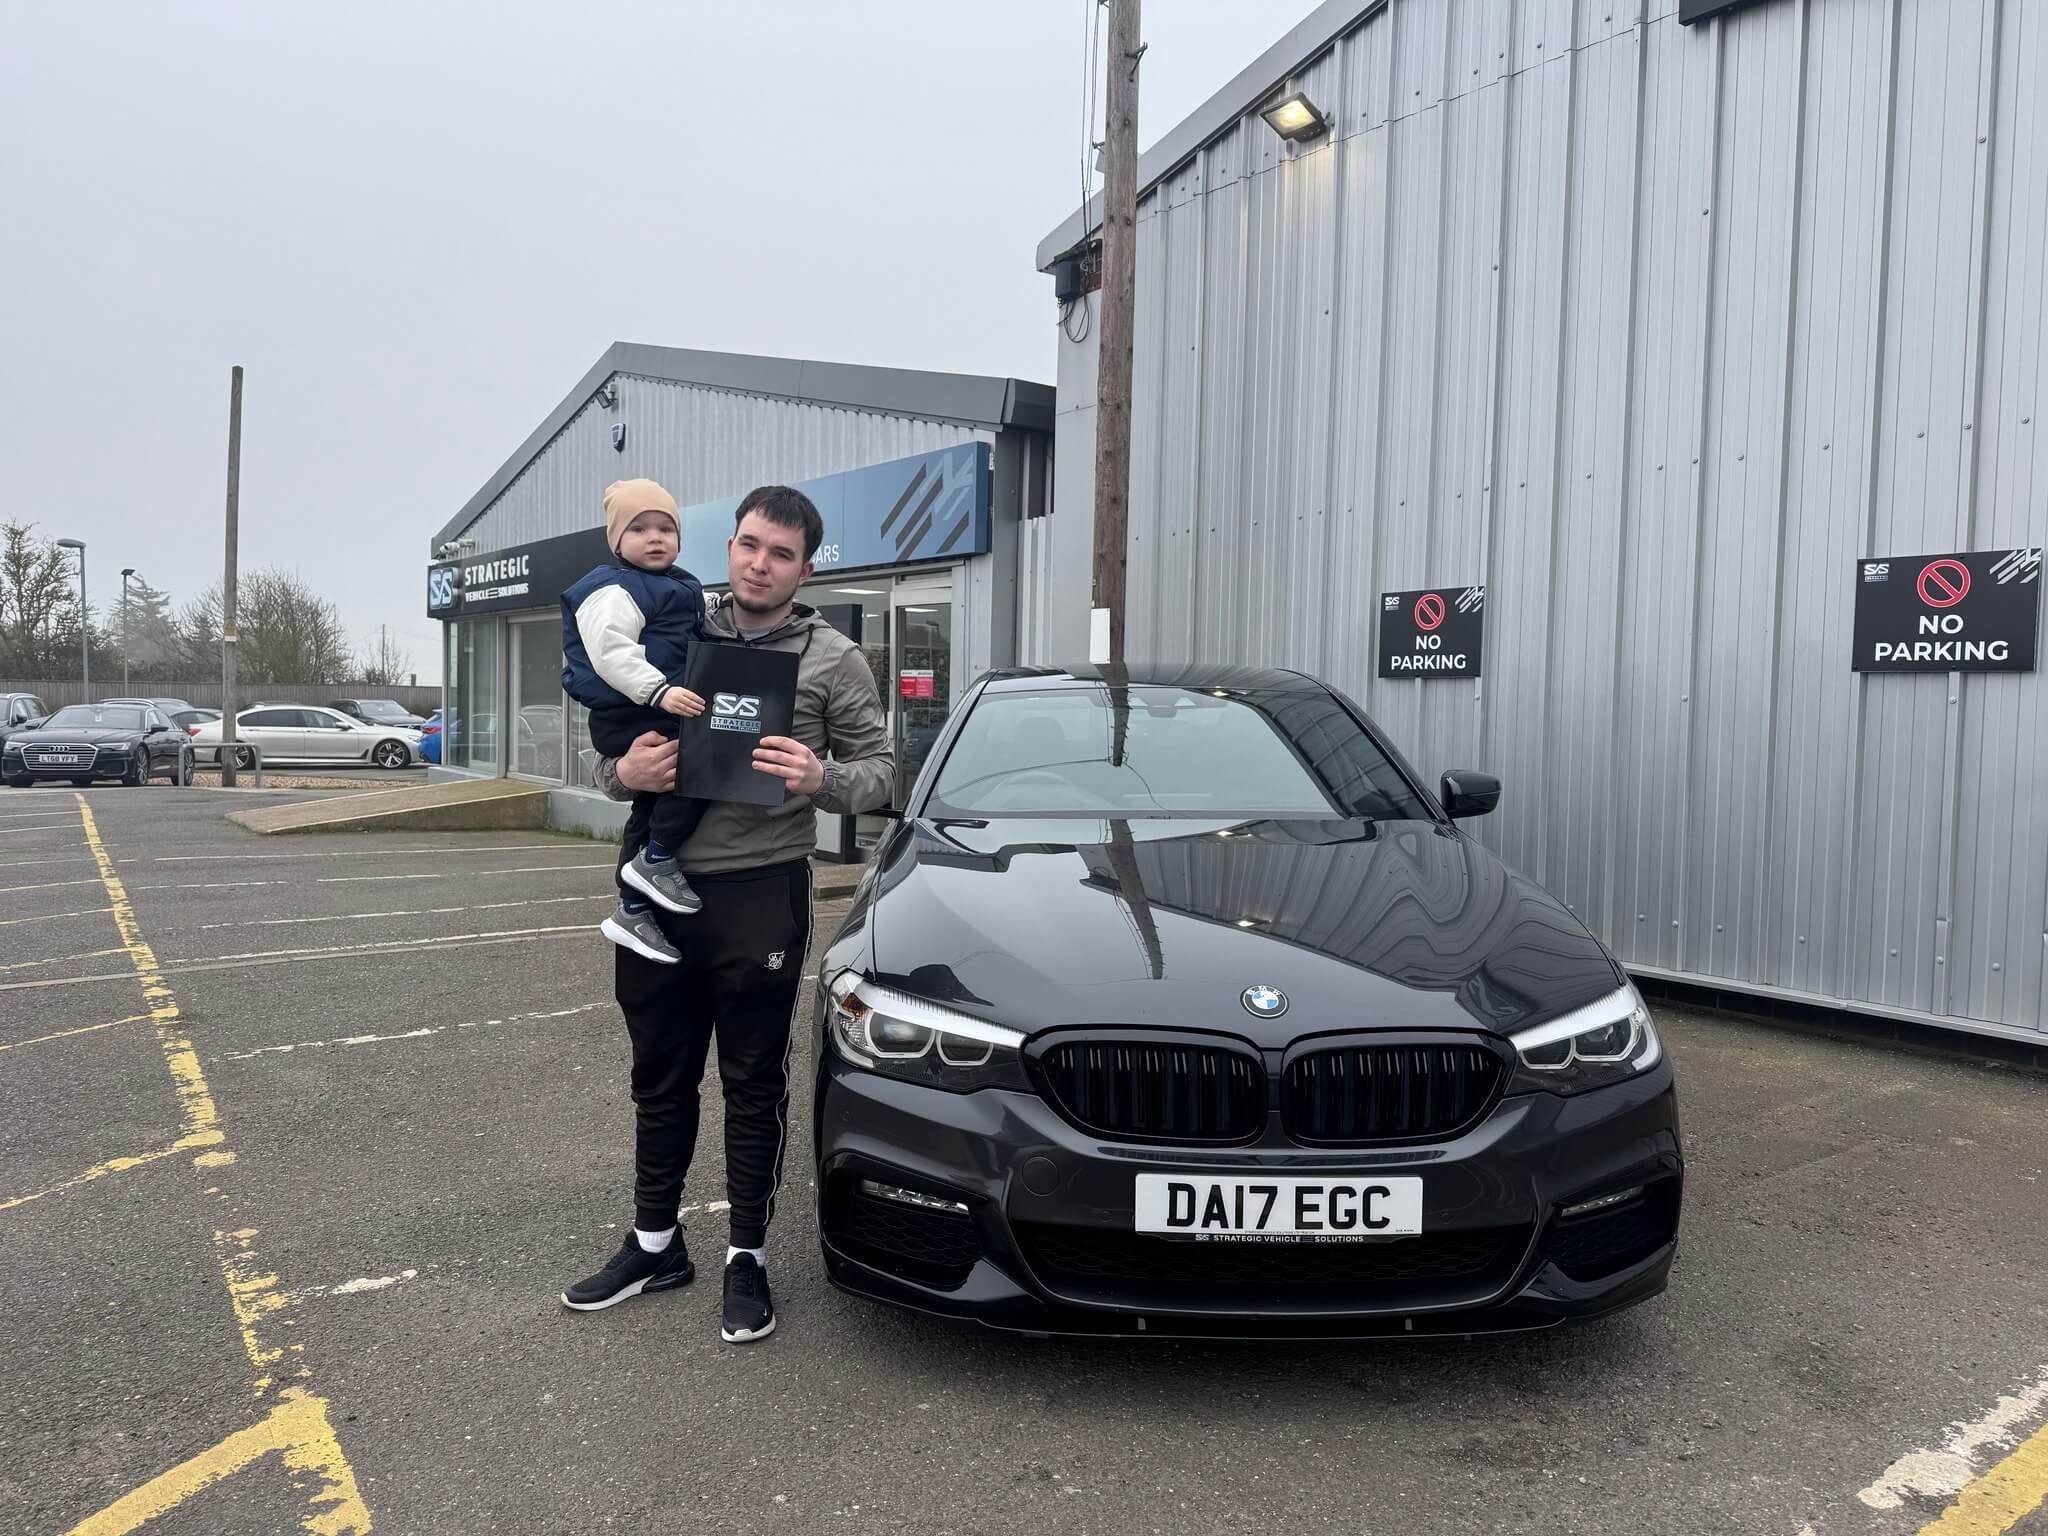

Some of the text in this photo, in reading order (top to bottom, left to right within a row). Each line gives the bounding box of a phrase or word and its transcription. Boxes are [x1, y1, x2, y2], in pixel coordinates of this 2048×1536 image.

[465, 555, 529, 586] STRATEGIC
[1918, 614, 1964, 635] NO
[1415, 634, 1441, 650] NO
[1875, 640, 2009, 661] PARKING
[1391, 654, 1466, 670] PARKING
[1166, 1182, 1391, 1230] DA17 EGC
[1264, 1235, 1300, 1243] VEHICLE
[1314, 1235, 1364, 1243] SOLUTIONS
